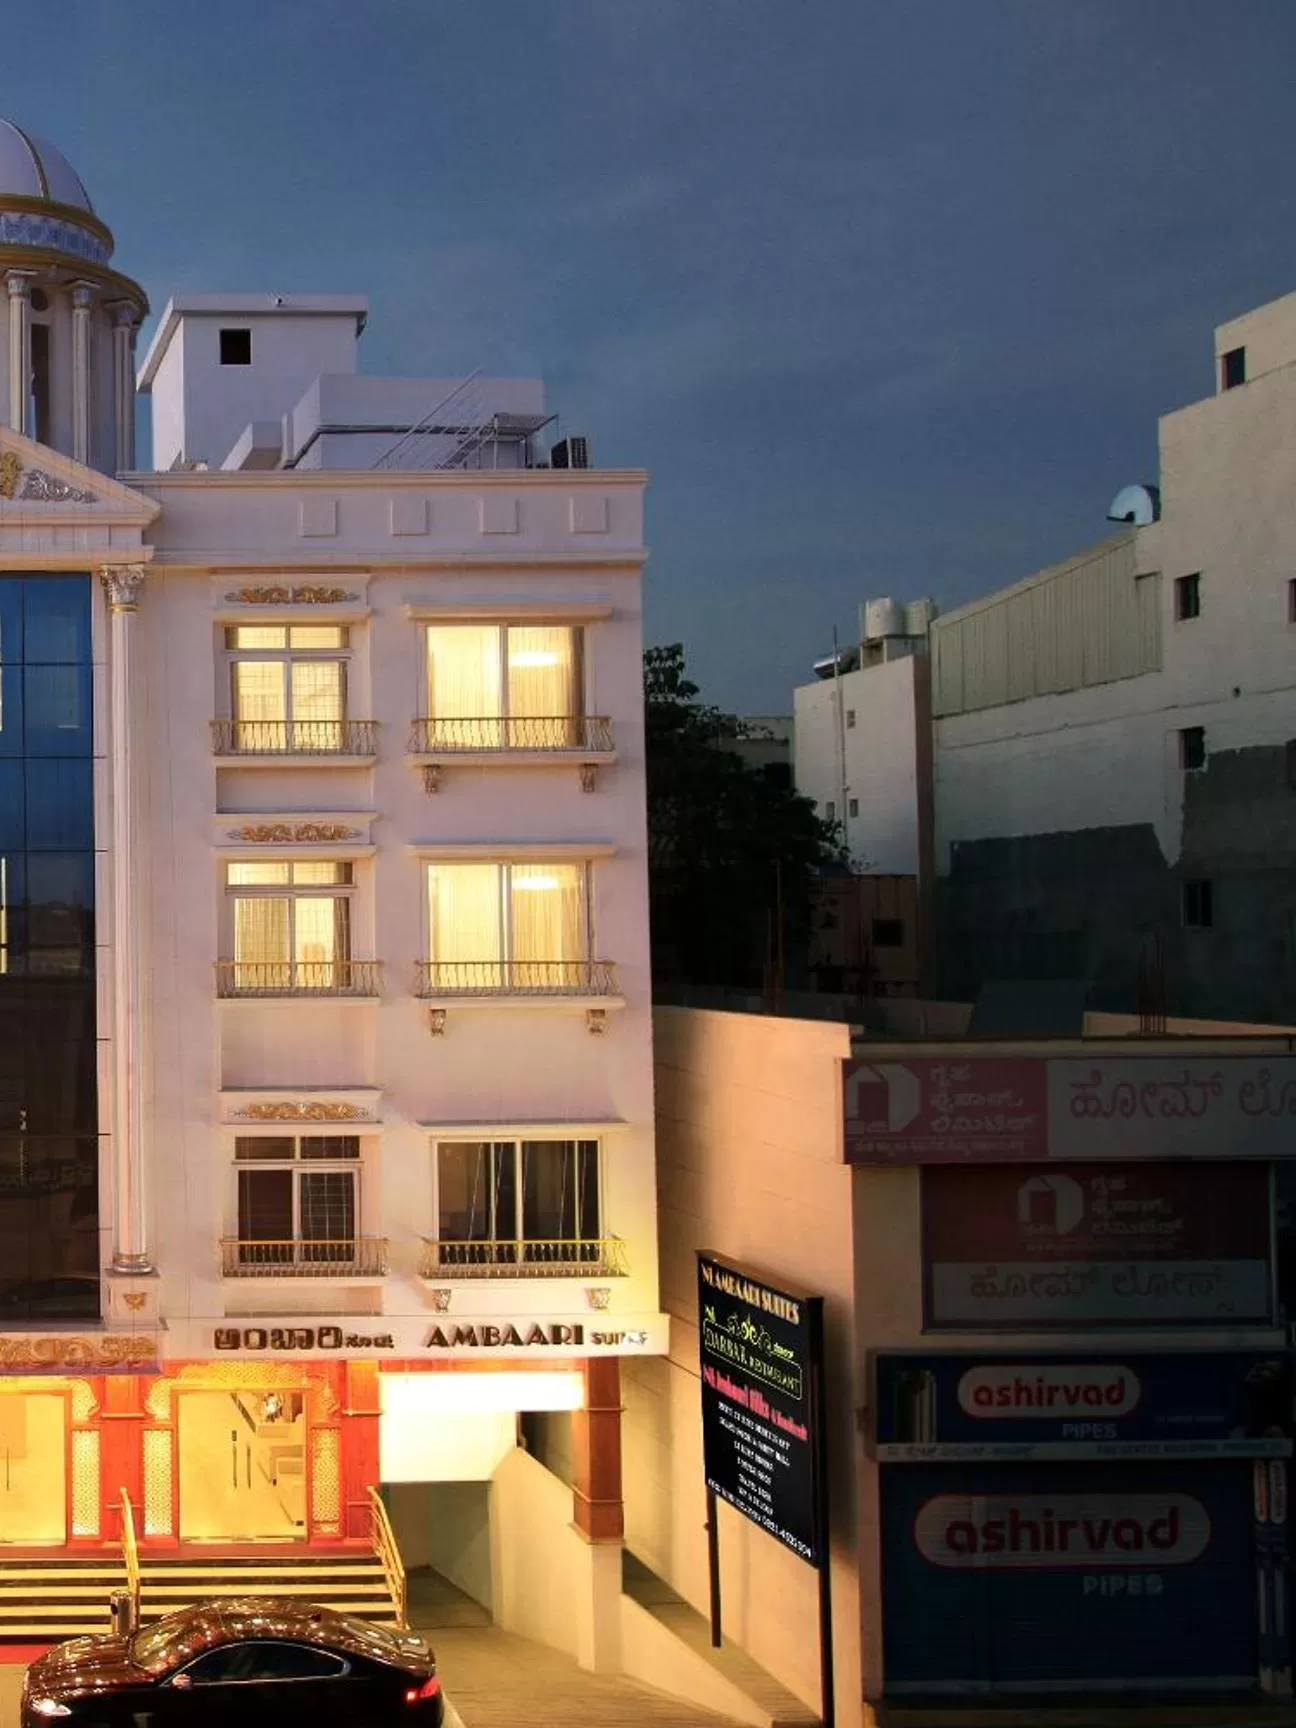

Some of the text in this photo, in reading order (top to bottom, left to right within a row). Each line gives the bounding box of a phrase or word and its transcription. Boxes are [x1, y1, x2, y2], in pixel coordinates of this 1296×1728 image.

[426, 1324, 584, 1348] AMBAARI
[973, 1376, 1126, 1407] ashirvad
[1063, 1422, 1117, 1439] PIPES
[945, 1505, 1180, 1554] ashirvad
[1083, 1573, 1164, 1597] PIPES
